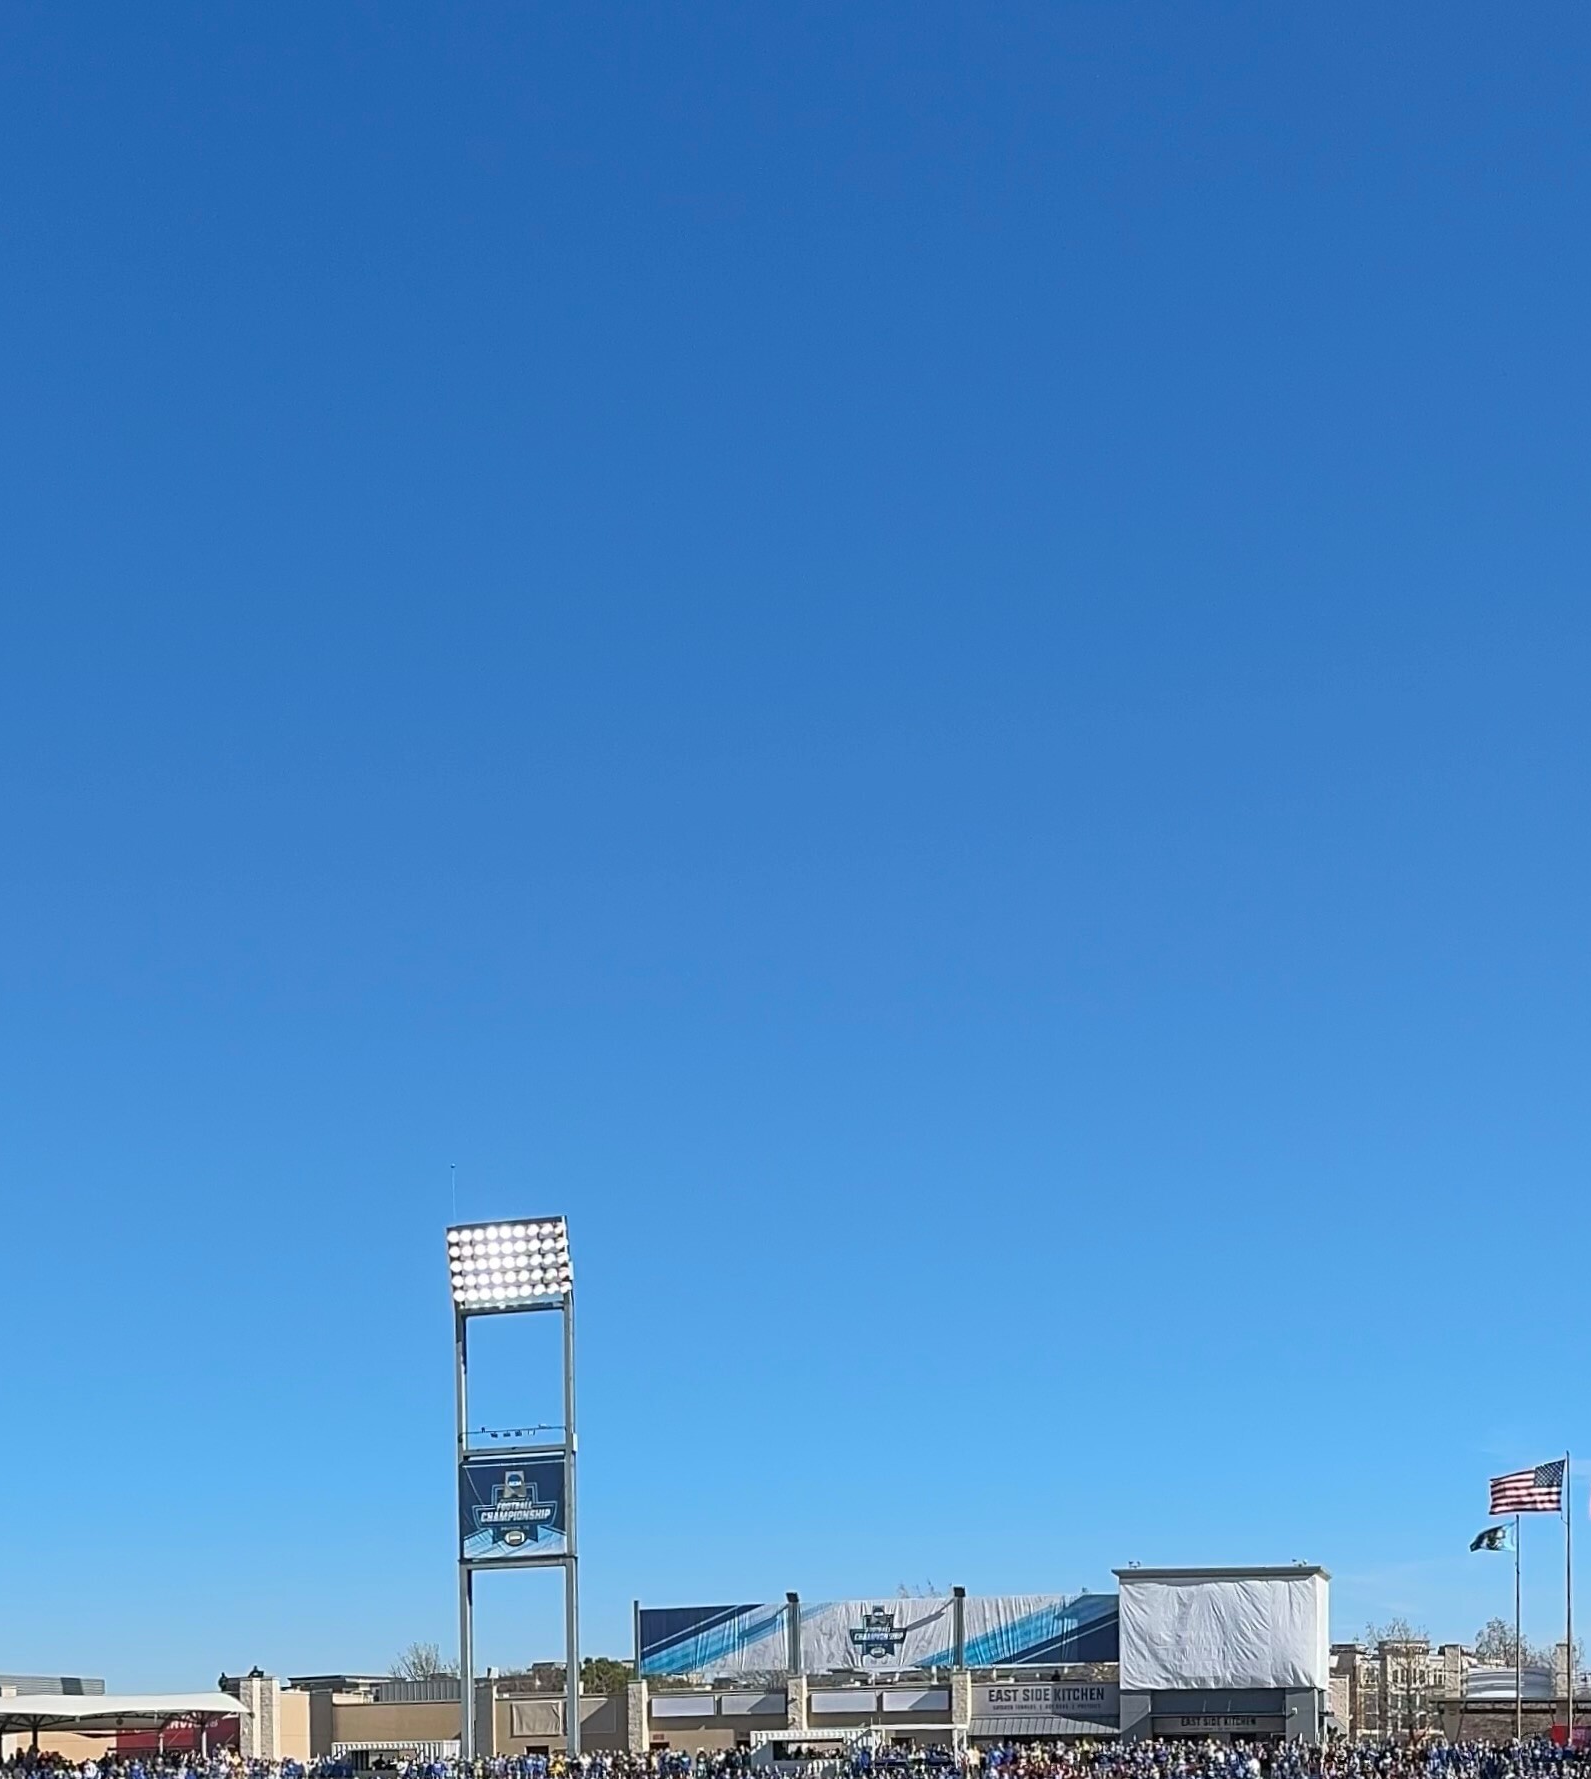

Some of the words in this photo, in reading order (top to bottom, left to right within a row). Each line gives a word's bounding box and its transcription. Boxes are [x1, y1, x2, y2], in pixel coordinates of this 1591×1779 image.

[496, 1501, 533, 1512] FOOTBALL
[480, 1508, 551, 1522] CHAMPIONSHIP
[988, 1689, 1019, 1702] EAST
[1022, 1688, 1050, 1701] SIDE
[1053, 1687, 1104, 1700] KITCHEN
